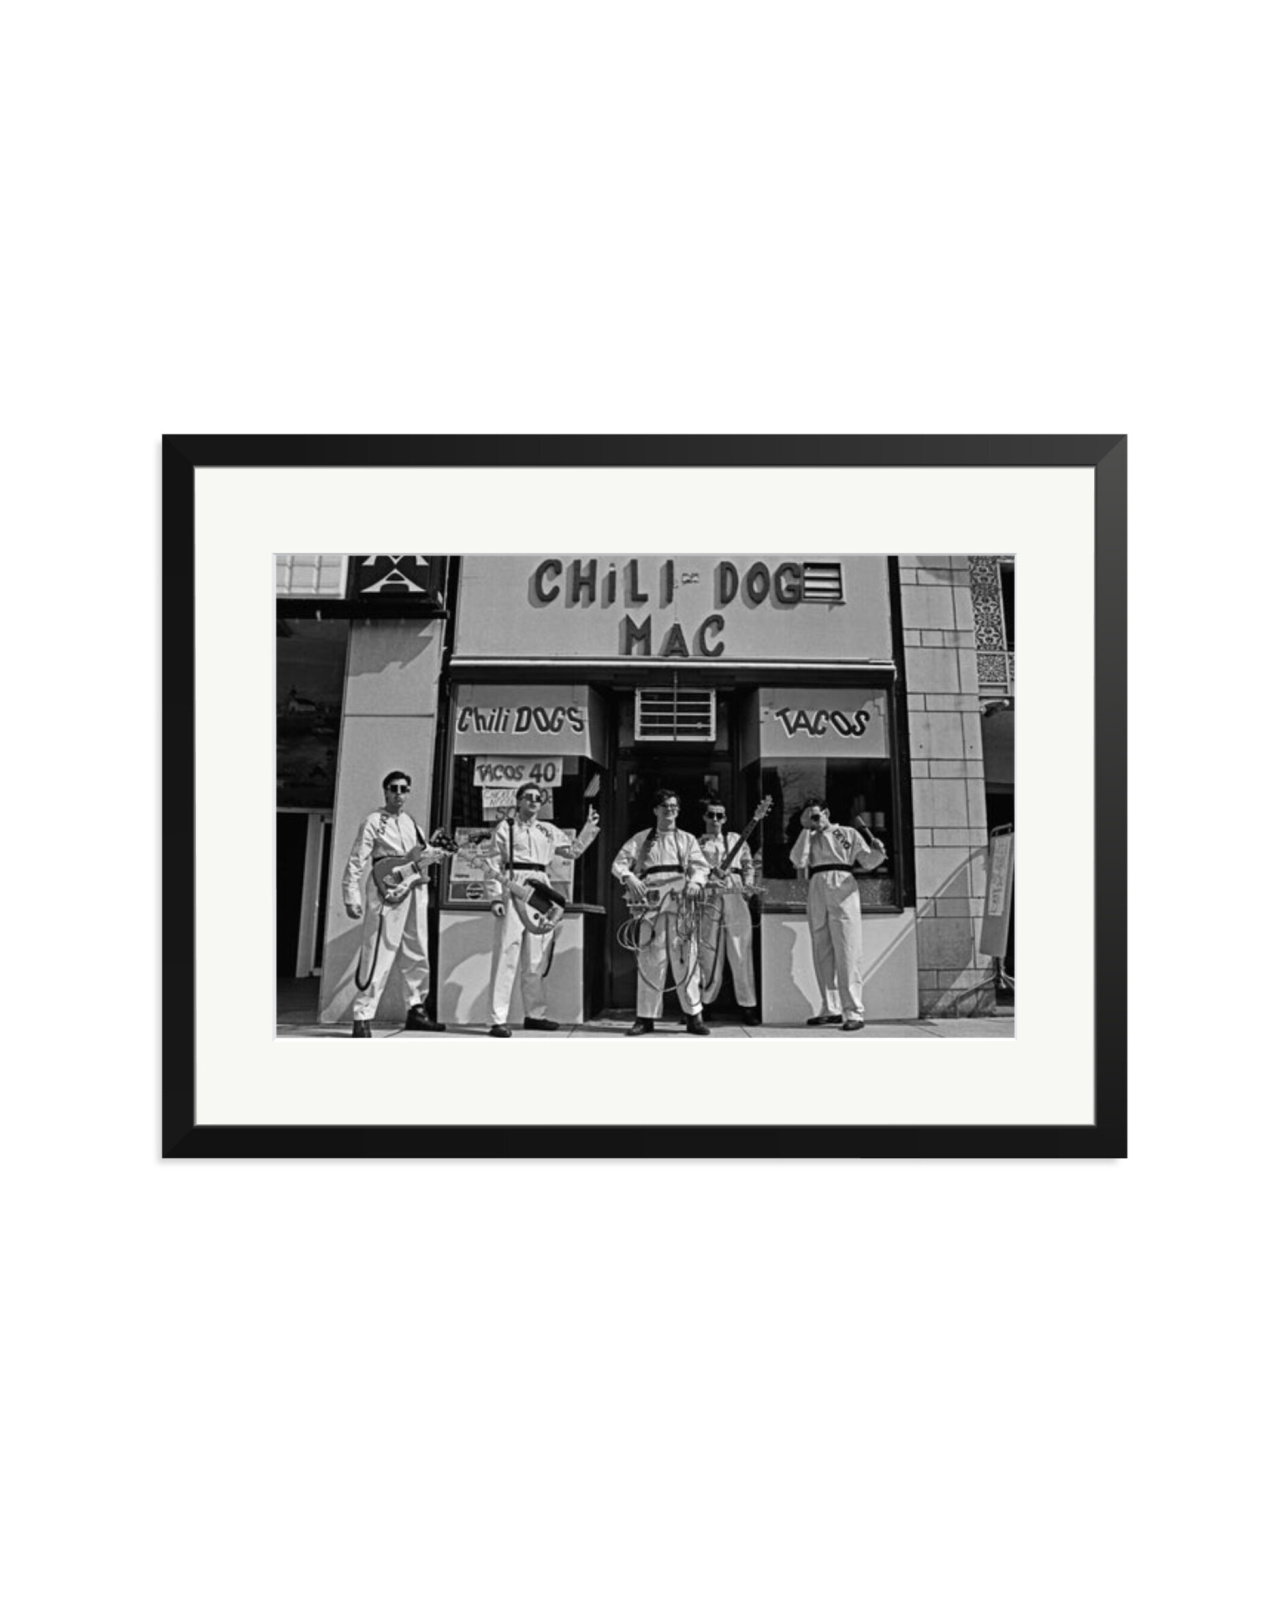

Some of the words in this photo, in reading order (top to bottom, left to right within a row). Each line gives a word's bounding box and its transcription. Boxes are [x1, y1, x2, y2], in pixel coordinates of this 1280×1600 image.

[618, 613, 725, 657] MAC
[457, 706, 510, 733] Chili
[513, 706, 585, 734] DOGS
[775, 707, 870, 737] TACOS
[477, 763, 525, 782] TACOS
[529, 762, 556, 783] 40
